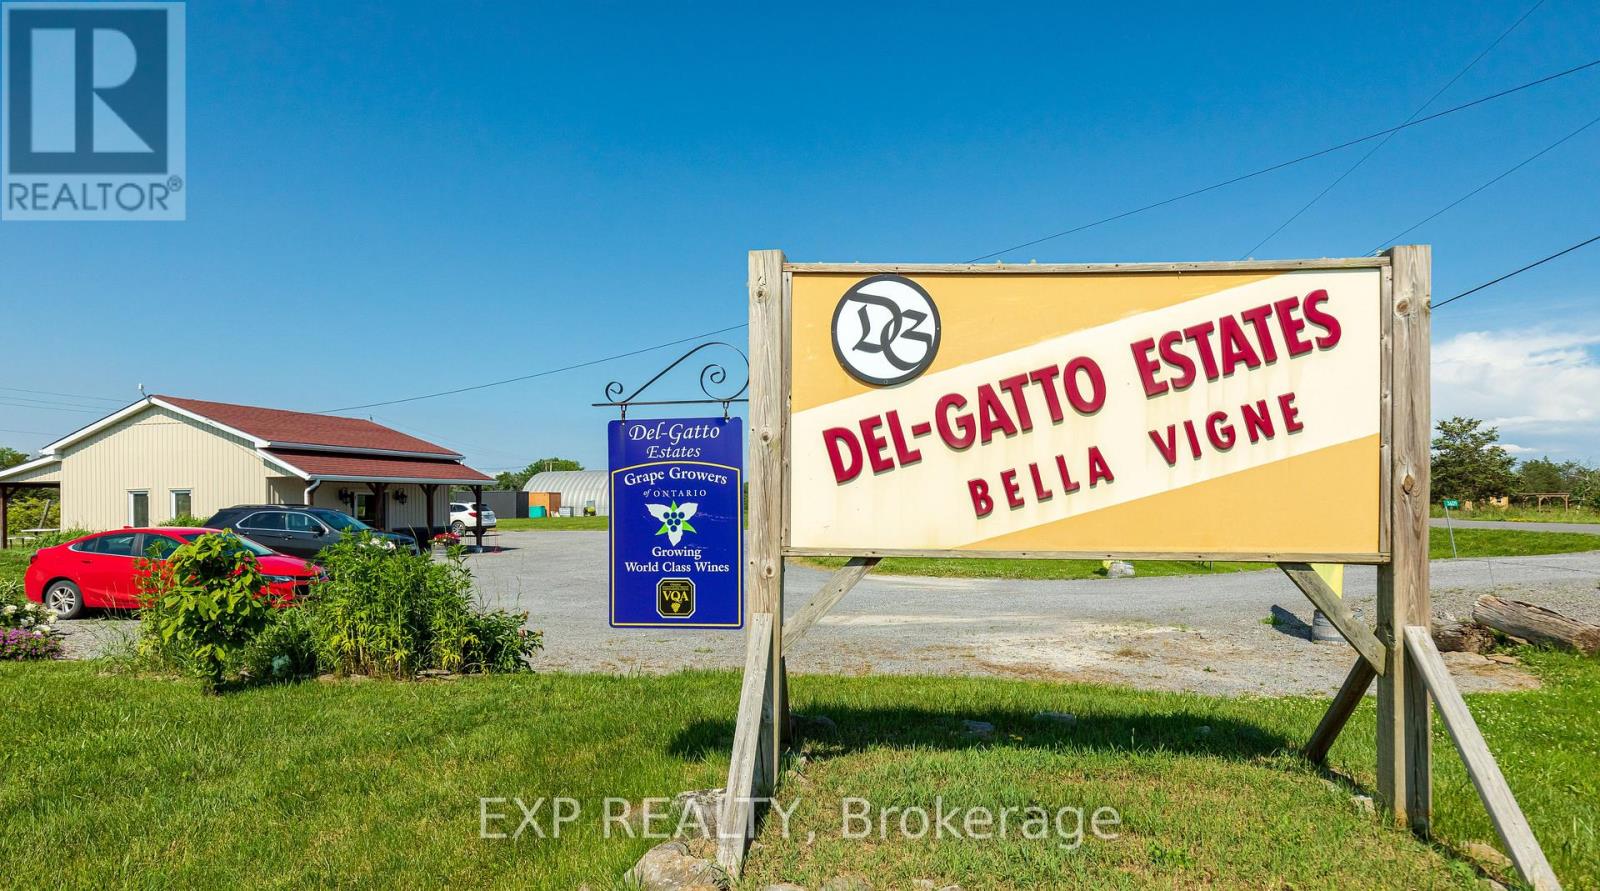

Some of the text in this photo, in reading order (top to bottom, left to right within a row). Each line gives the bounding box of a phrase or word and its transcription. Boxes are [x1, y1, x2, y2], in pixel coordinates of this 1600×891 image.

[822, 289, 1342, 485] DEL-GATTO ESTATES
[629, 421, 720, 446] Del-Gatto
[646, 445, 701, 459] Estates
[968, 392, 1304, 517] BELLA VIGNE
[624, 466, 728, 486] Grape Growers
[643, 489, 707, 498] of ONTARIO
[651, 547, 702, 560] Growing
[625, 562, 730, 572] World Class Wines
[662, 590, 689, 603] VQA
